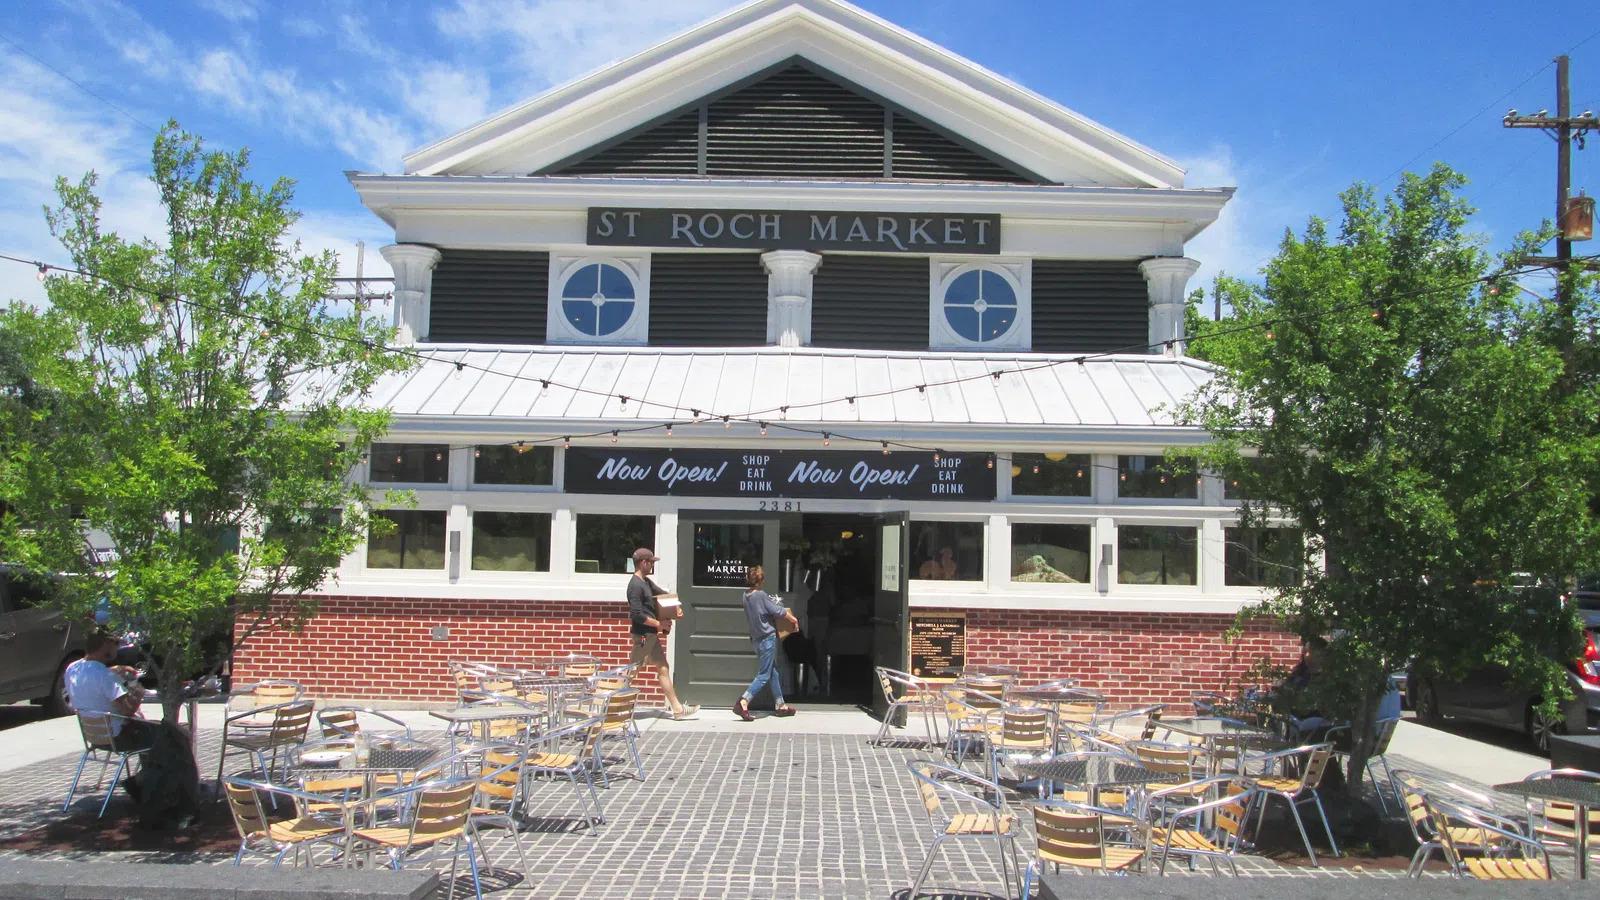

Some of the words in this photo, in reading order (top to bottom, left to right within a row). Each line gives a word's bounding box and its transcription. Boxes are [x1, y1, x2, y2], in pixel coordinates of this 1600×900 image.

[597, 211, 641, 238] ST
[670, 213, 782, 247] ROCH
[808, 215, 992, 250] MARKET
[742, 455, 770, 466] SHOP
[933, 458, 962, 468] SHOP
[596, 457, 652, 481] Now
[657, 457, 729, 489] Open!
[746, 468, 765, 479] EAT
[787, 460, 843, 485] Now
[849, 461, 920, 492] Open!
[938, 470, 957, 481] EAT
[739, 480, 772, 492] DRINK
[931, 483, 964, 494] DRINK
[758, 501, 802, 512] 2381
[707, 565, 749, 574] MARKET
